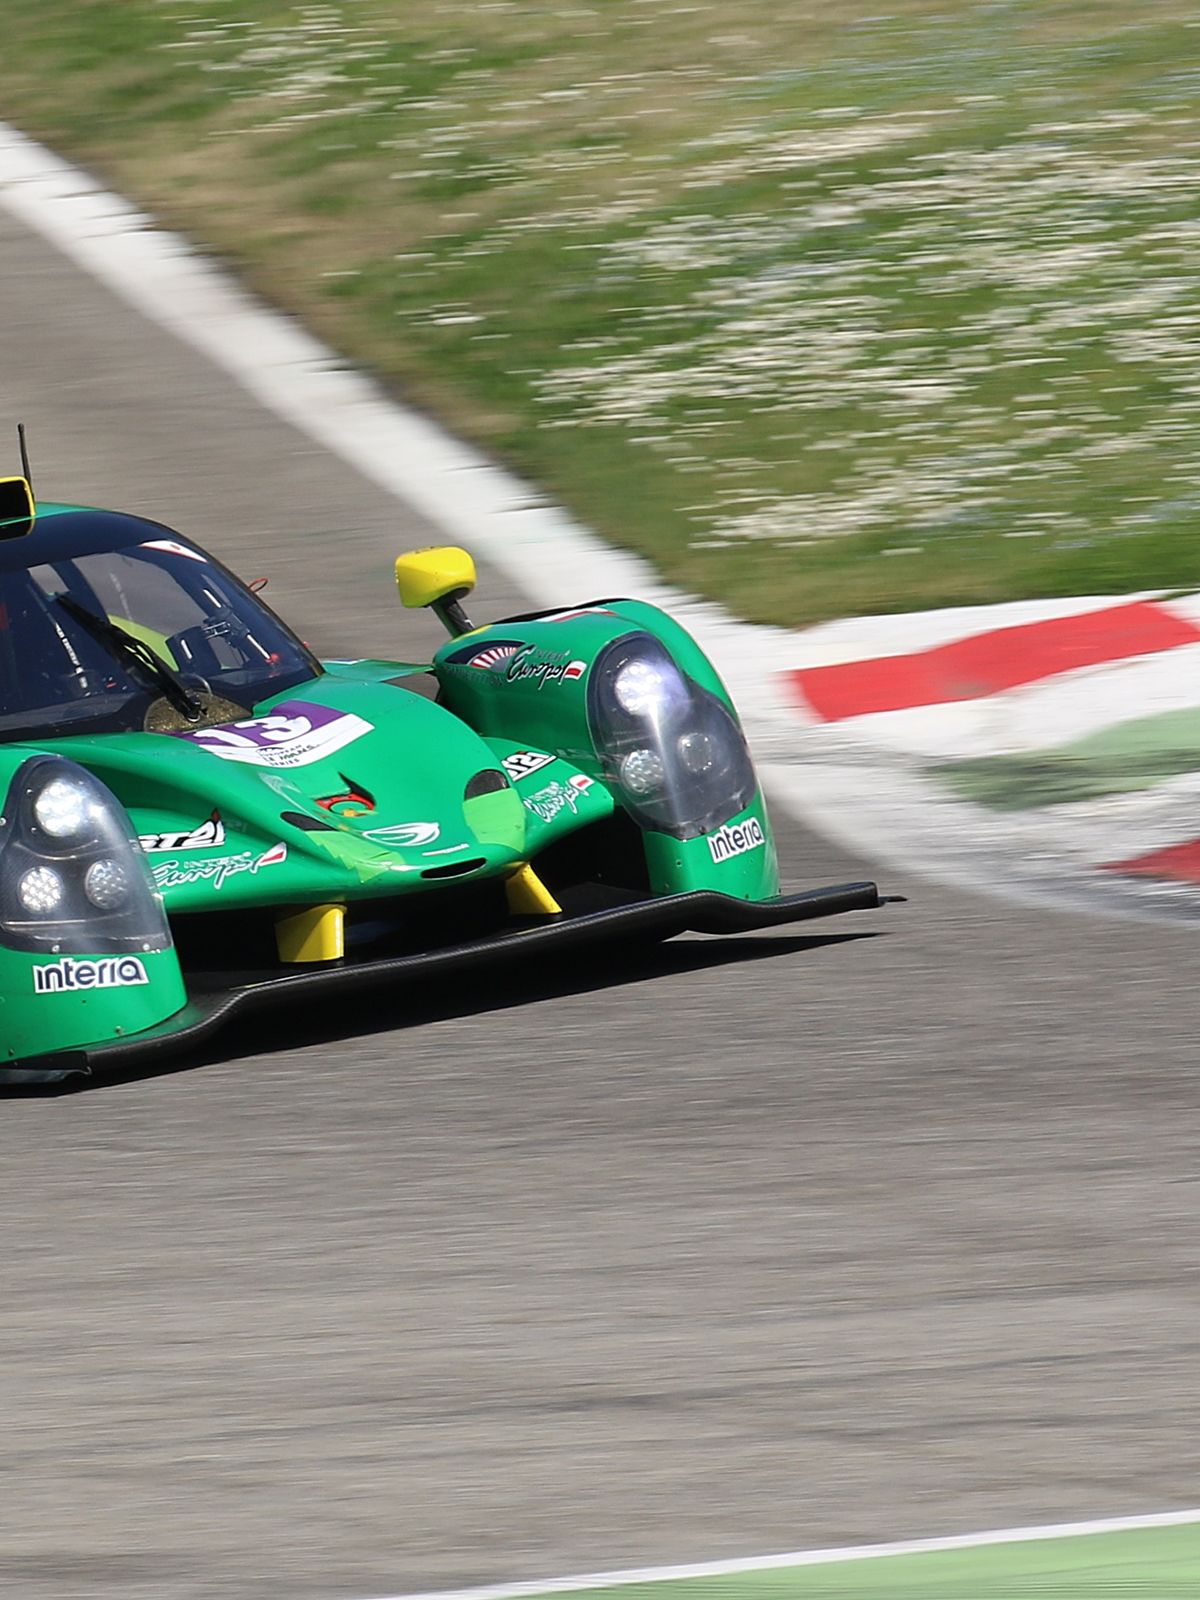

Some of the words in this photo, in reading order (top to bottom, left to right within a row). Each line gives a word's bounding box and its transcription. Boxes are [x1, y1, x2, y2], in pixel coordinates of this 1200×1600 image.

[192, 715, 313, 748] 13
[711, 820, 762, 860] interia
[37, 959, 144, 991] interia
